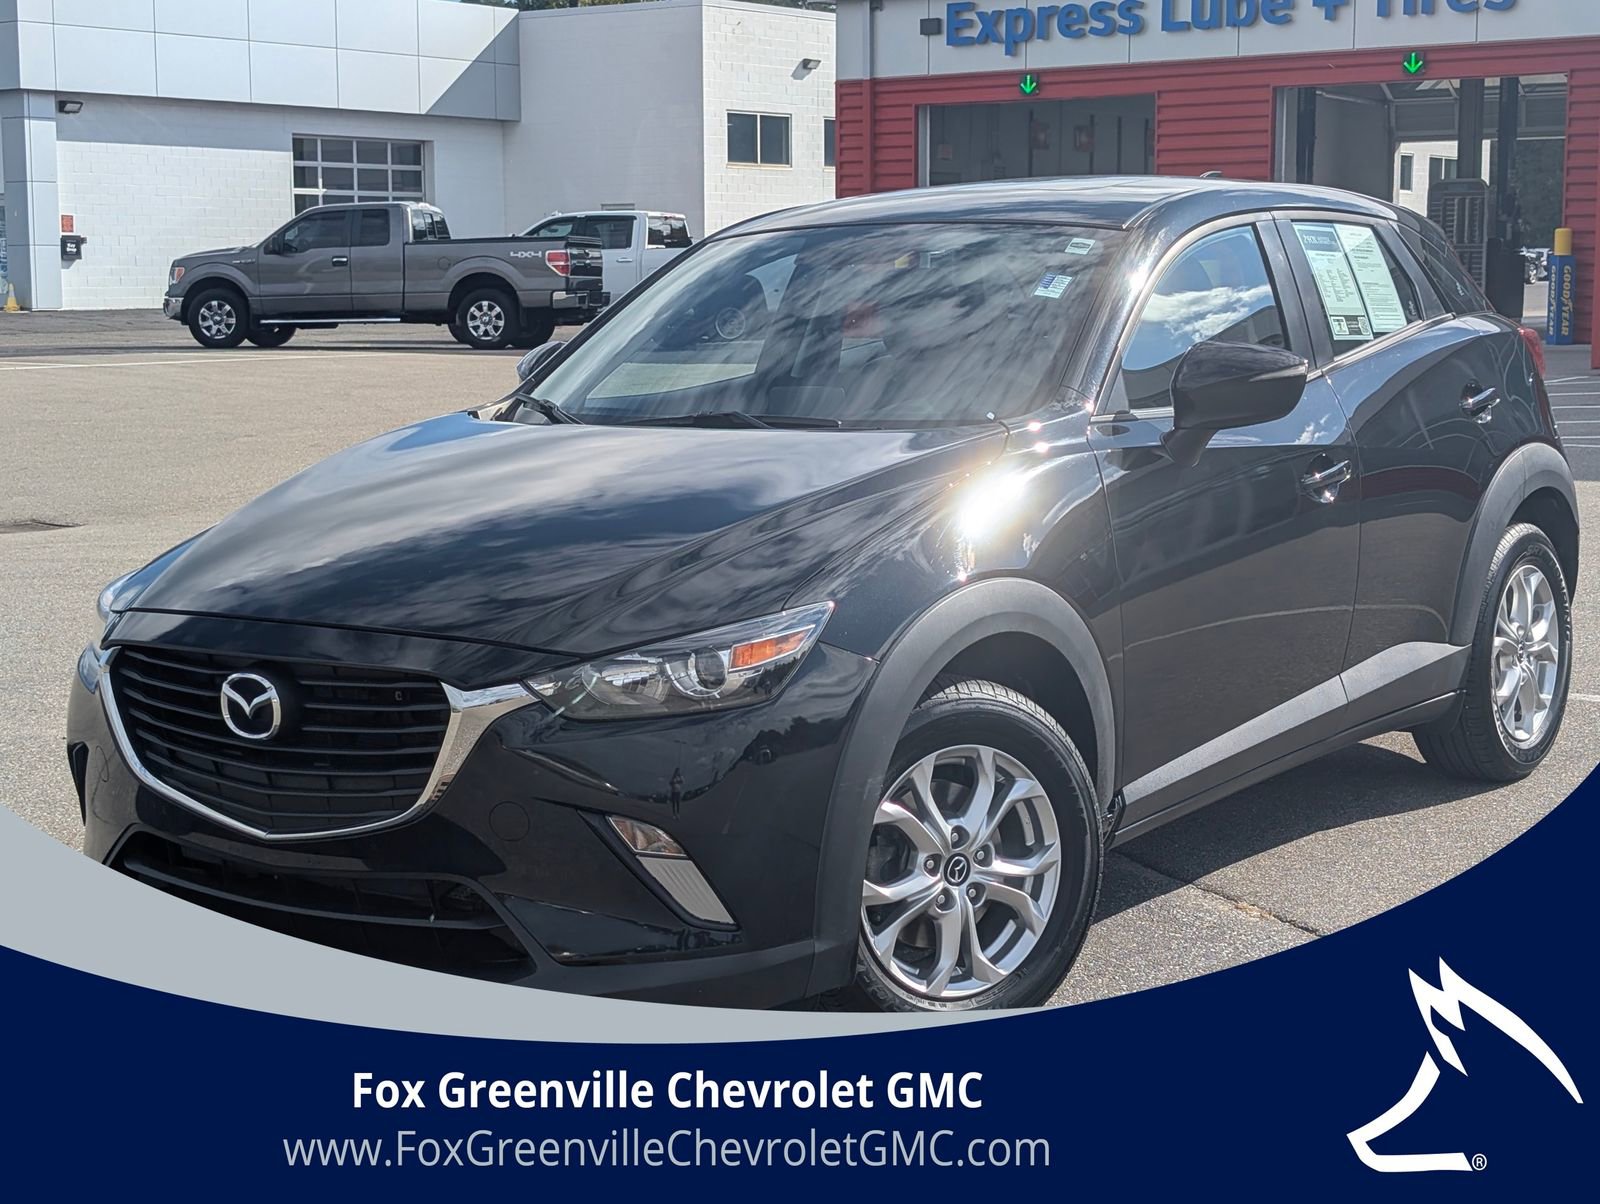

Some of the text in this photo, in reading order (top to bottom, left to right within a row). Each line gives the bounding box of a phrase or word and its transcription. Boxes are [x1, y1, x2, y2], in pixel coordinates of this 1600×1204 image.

[946, 0, 1147, 56] Express
[1160, 0, 1295, 33] Lube
[1548, 265, 1556, 335] GOODYEAR
[1560, 265, 1573, 336] GOODYEAR
